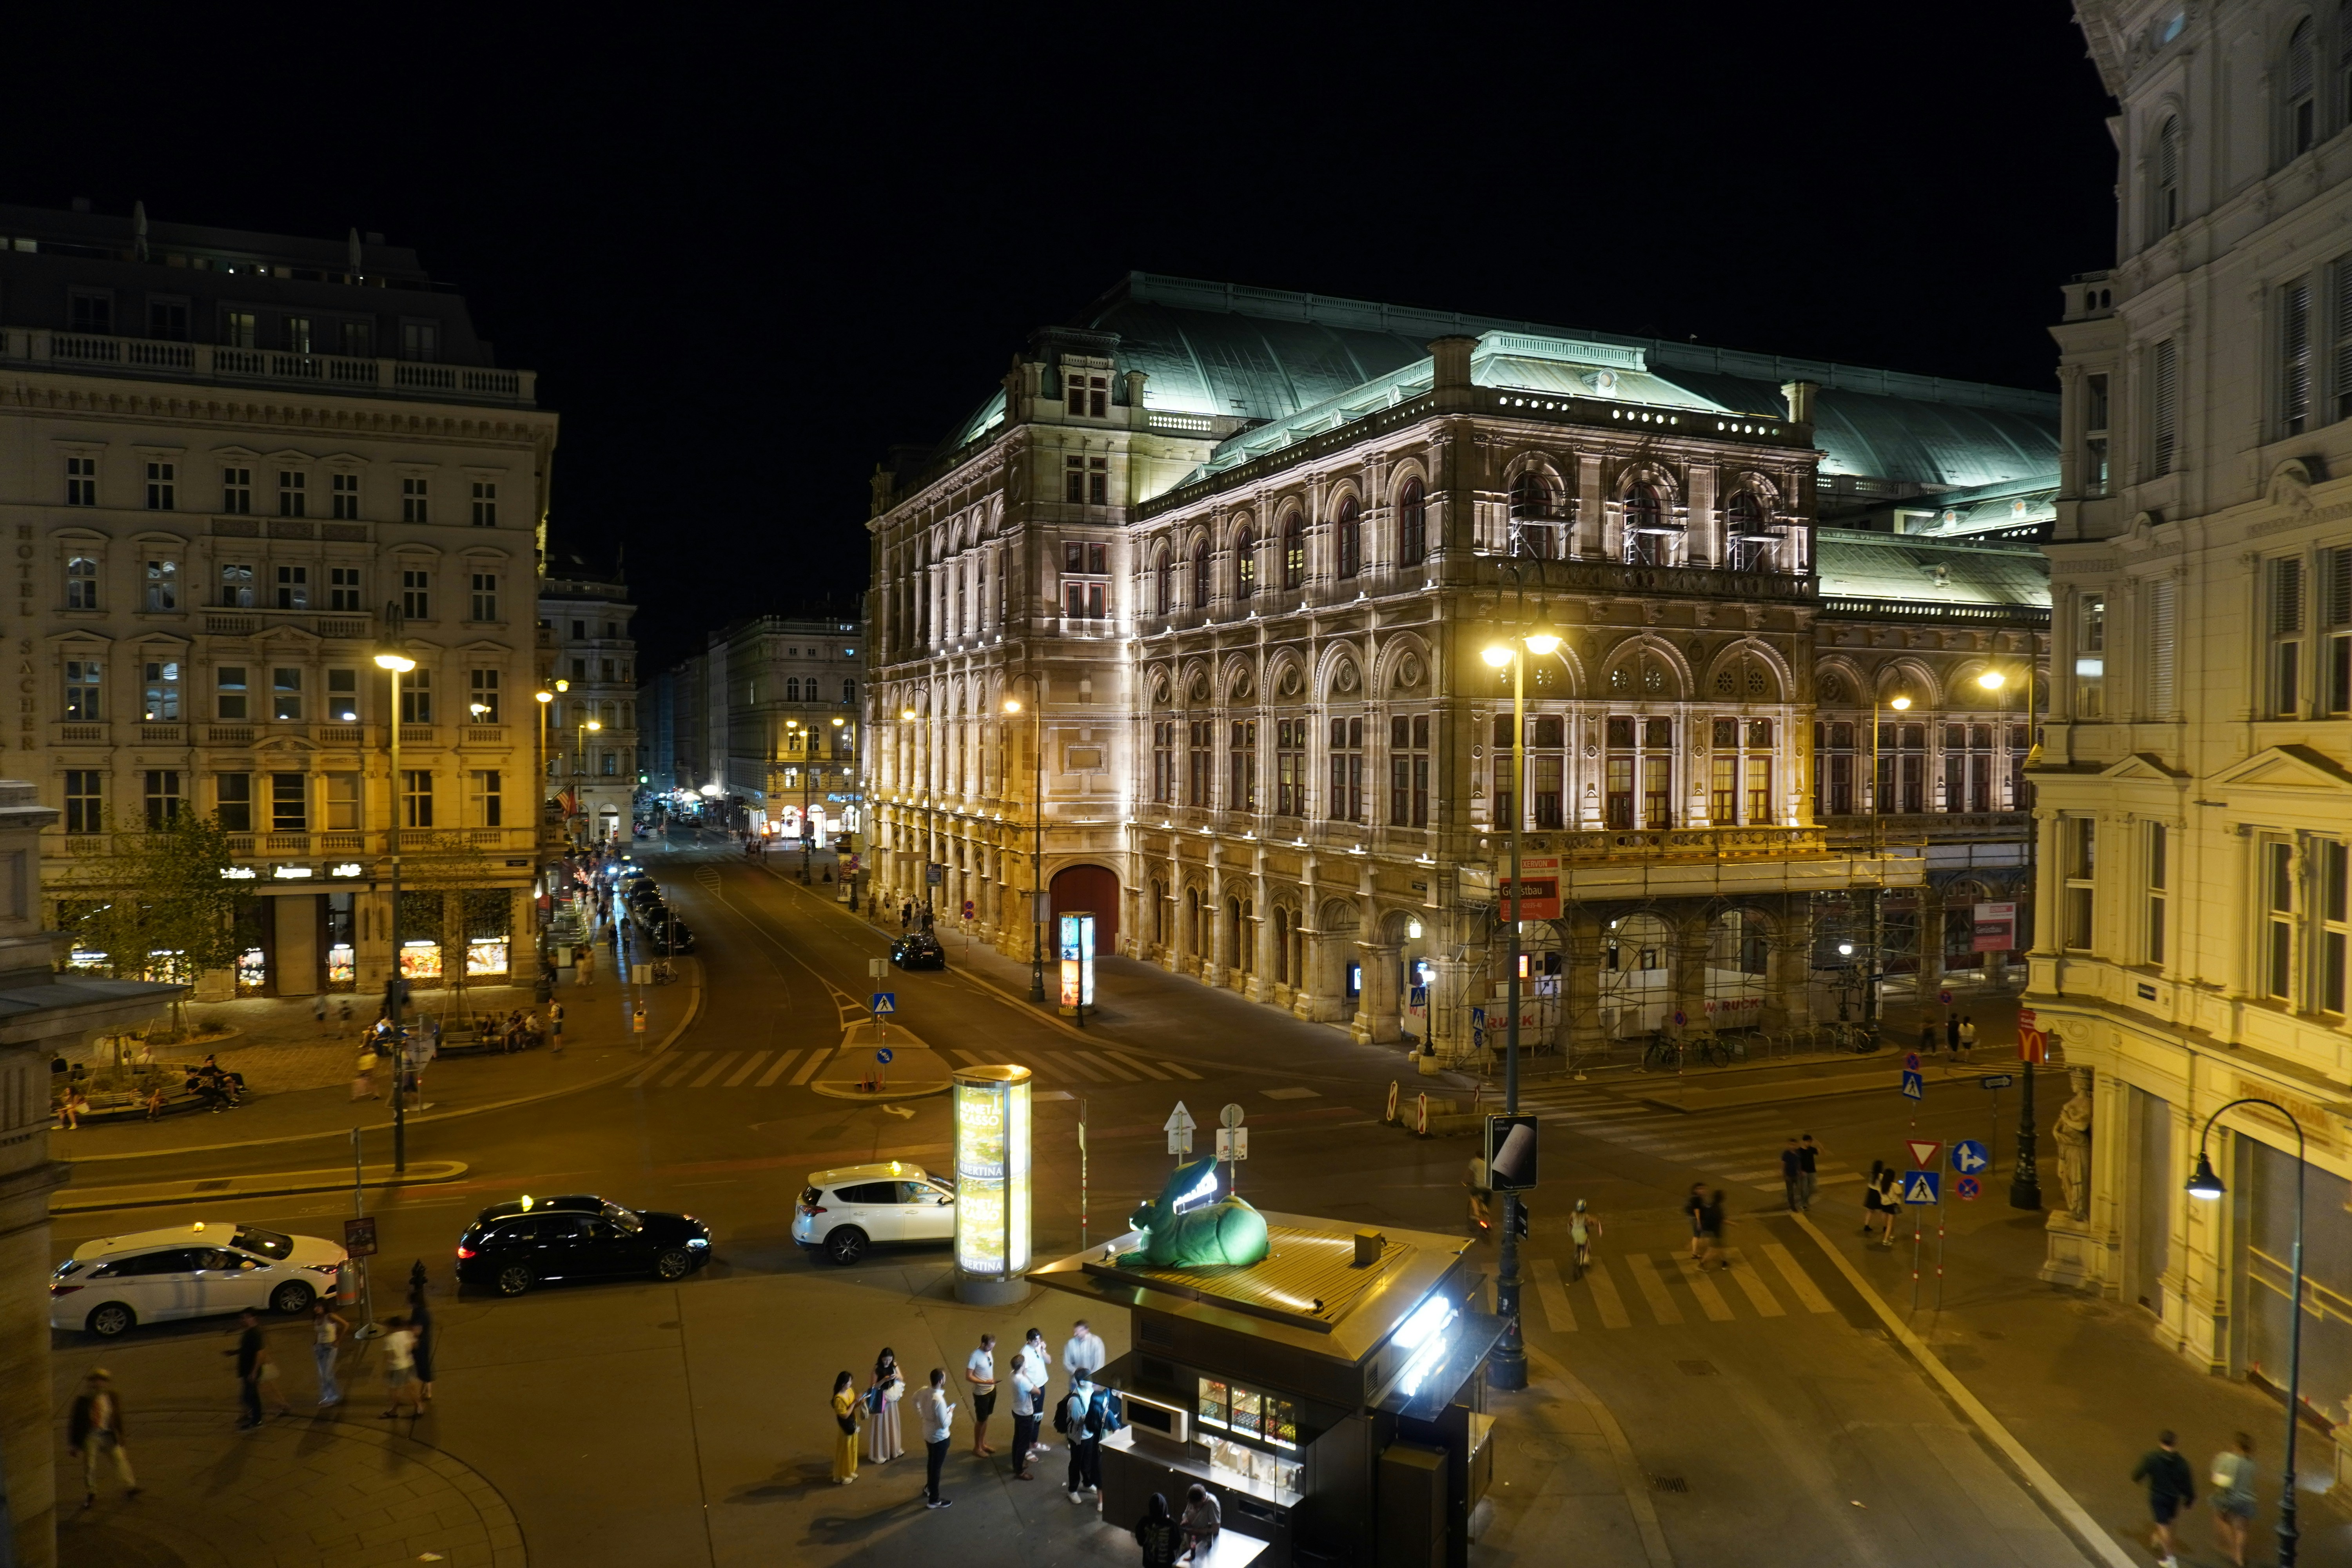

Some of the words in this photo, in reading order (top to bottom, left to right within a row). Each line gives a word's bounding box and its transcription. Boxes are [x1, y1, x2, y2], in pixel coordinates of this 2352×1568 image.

[17, 525, 34, 617] HOTEL
[20, 637, 35, 751] SACHER
[1522, 859, 1548, 867] XERVON
[1502, 885, 1543, 897] Gestbau
[1722, 998, 1759, 1011] RUCK
[1487, 1015, 1534, 1029] RUK
